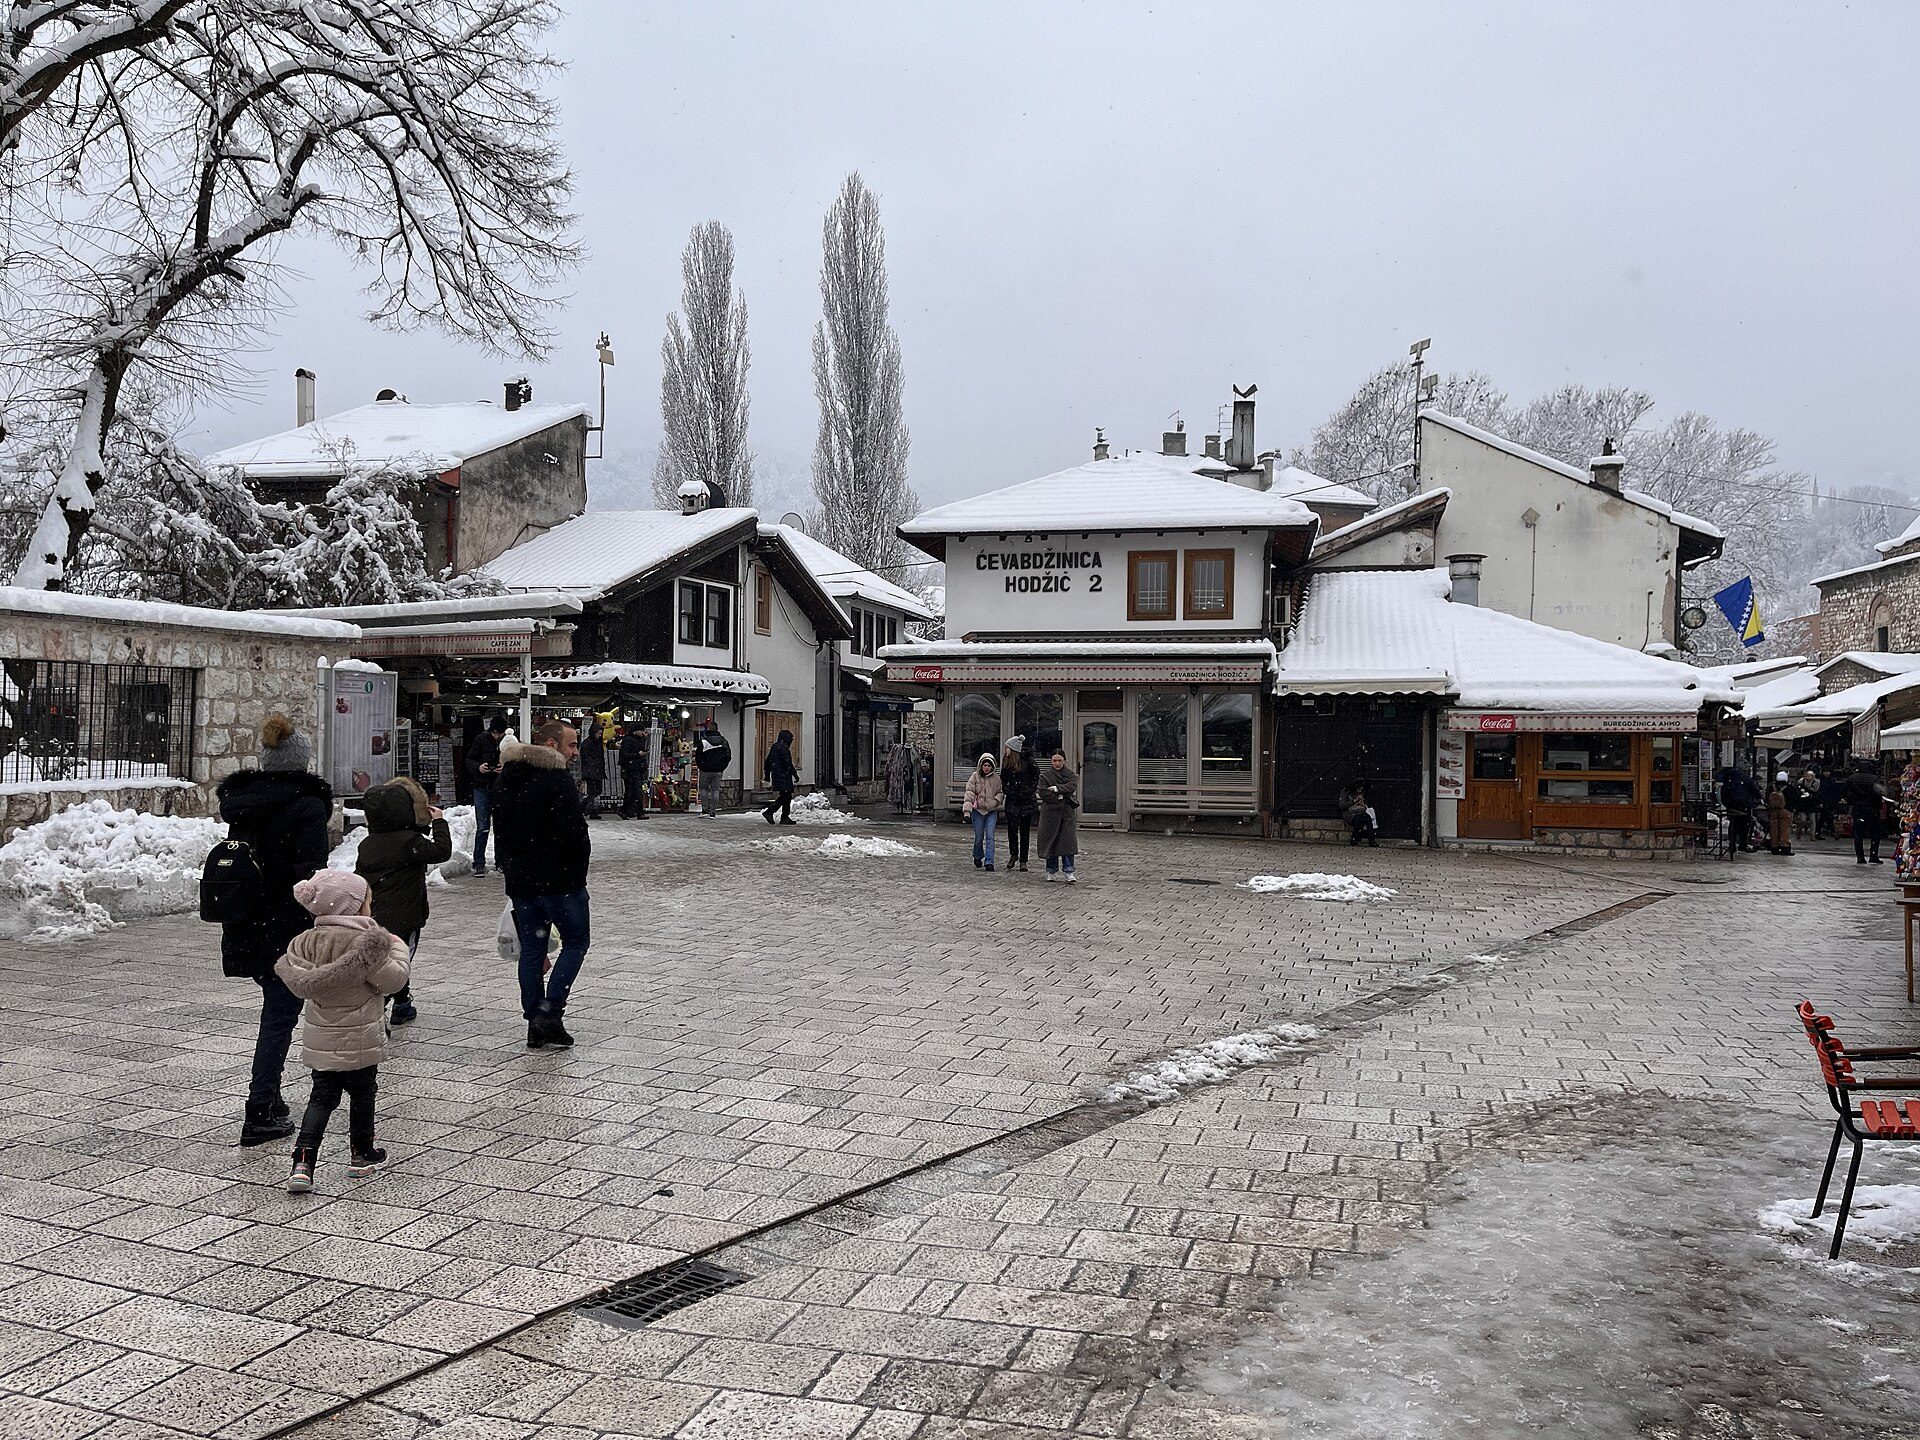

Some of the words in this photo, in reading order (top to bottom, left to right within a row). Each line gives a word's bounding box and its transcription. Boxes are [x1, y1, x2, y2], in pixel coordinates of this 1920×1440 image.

[976, 548, 1102, 570] ĆEVABDŽINICA
[1089, 574, 1102, 592] 2
[914, 669, 940, 679] Coca-Cola
[1481, 718, 1513, 729] Coca-Cola
